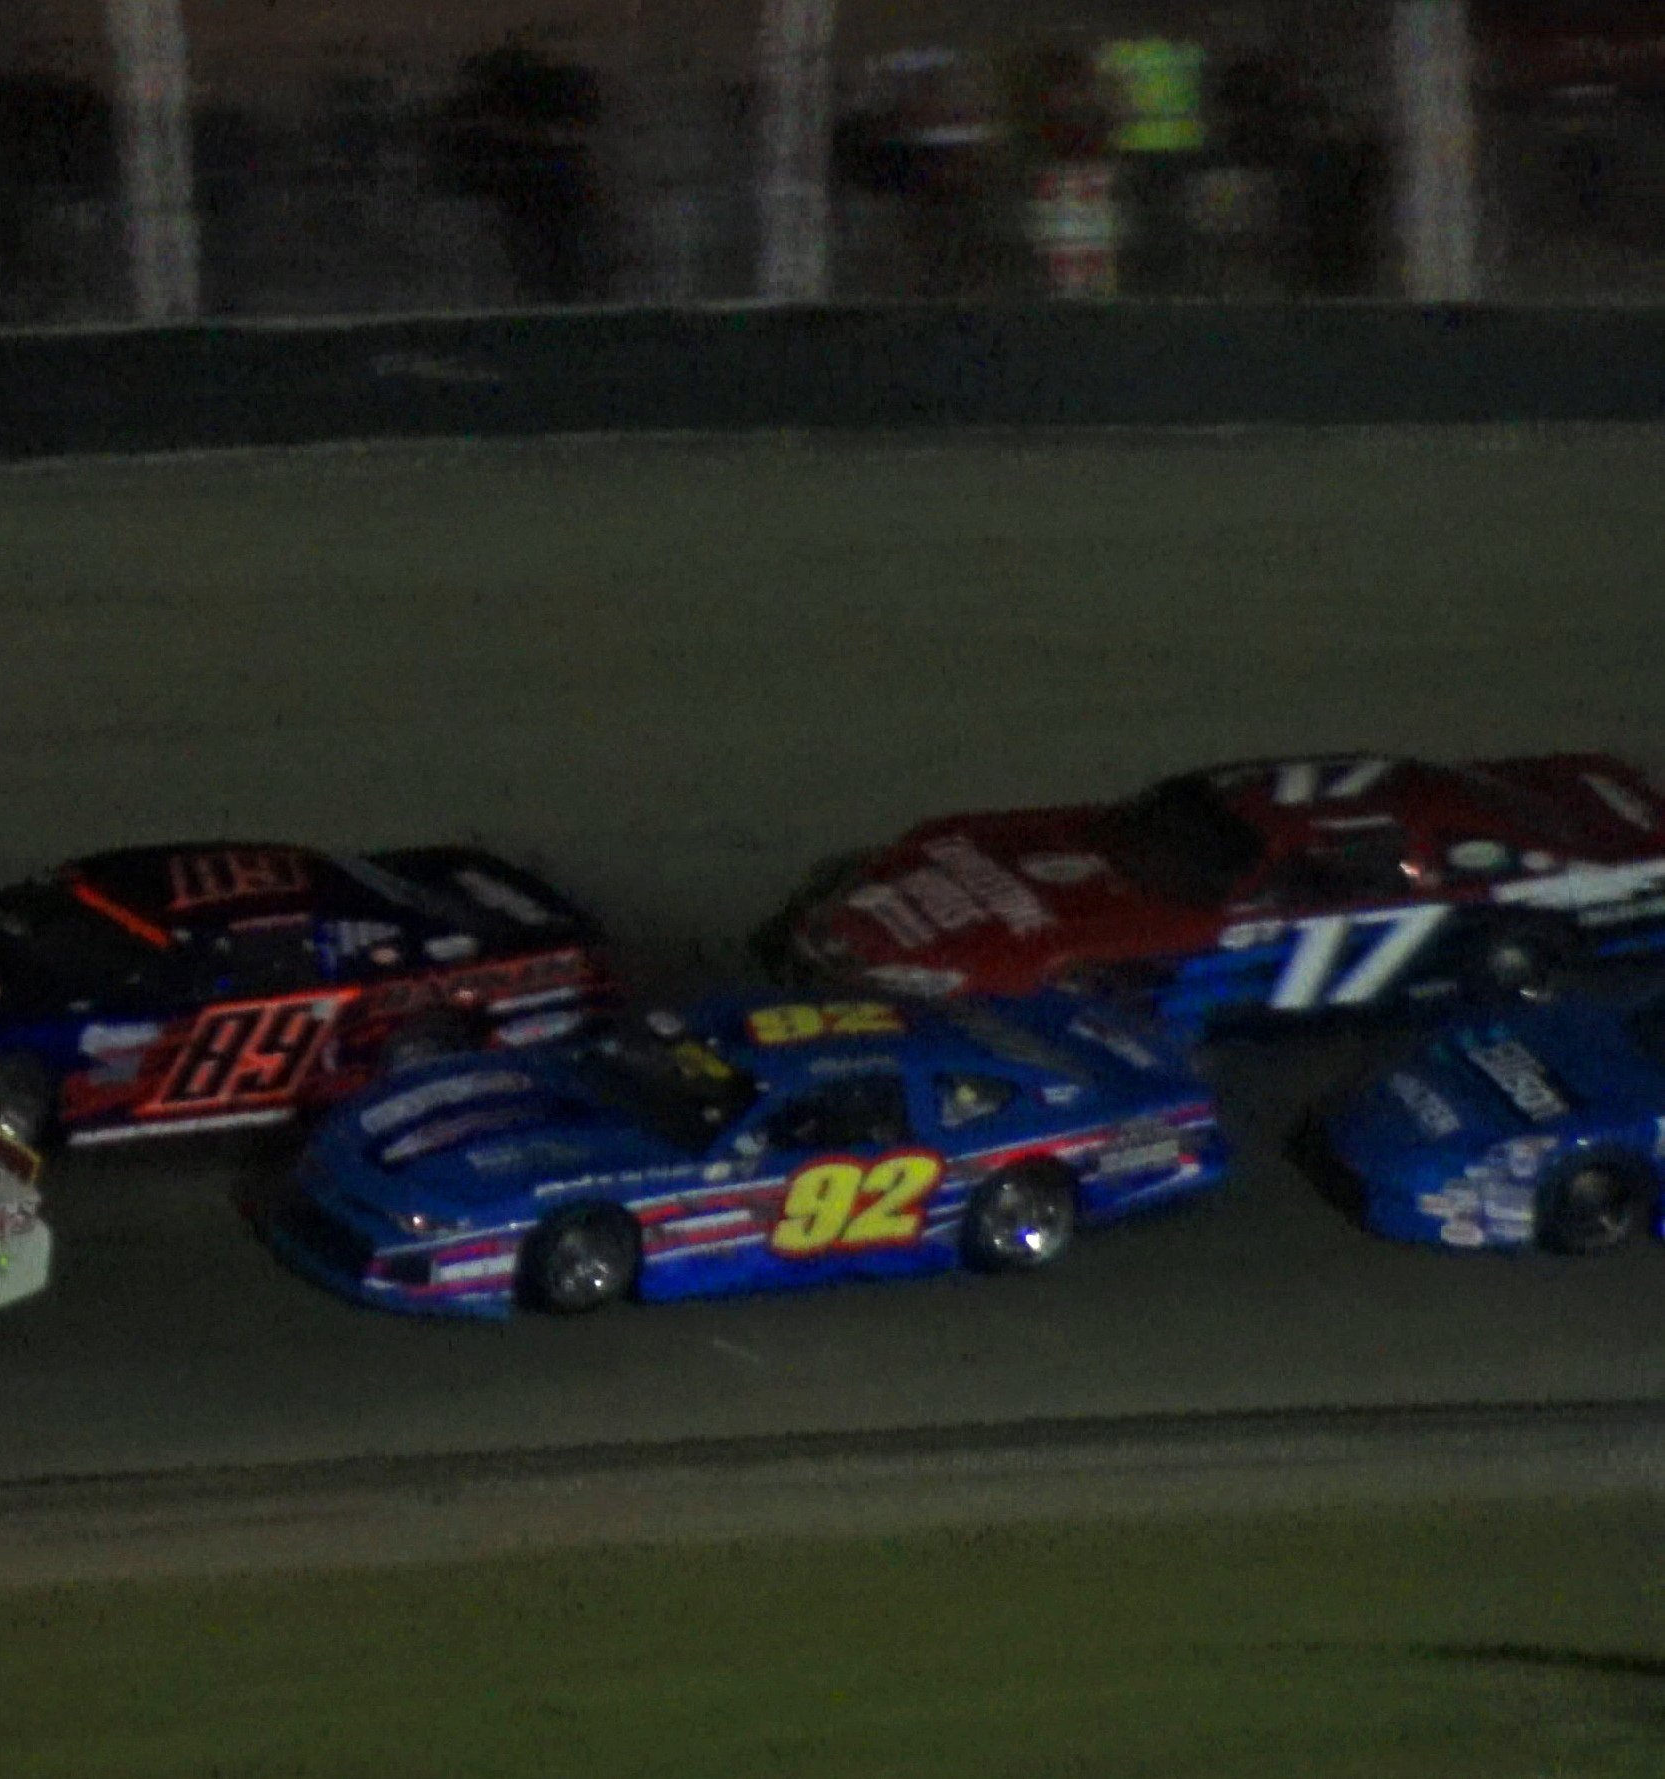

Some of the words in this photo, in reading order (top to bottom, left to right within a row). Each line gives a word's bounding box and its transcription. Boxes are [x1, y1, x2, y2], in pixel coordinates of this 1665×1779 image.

[1271, 757, 1396, 806] 17
[1270, 902, 1454, 1011] 17
[162, 998, 332, 1112] 89
[746, 1000, 900, 1047] 92
[768, 1146, 949, 1262] 92
